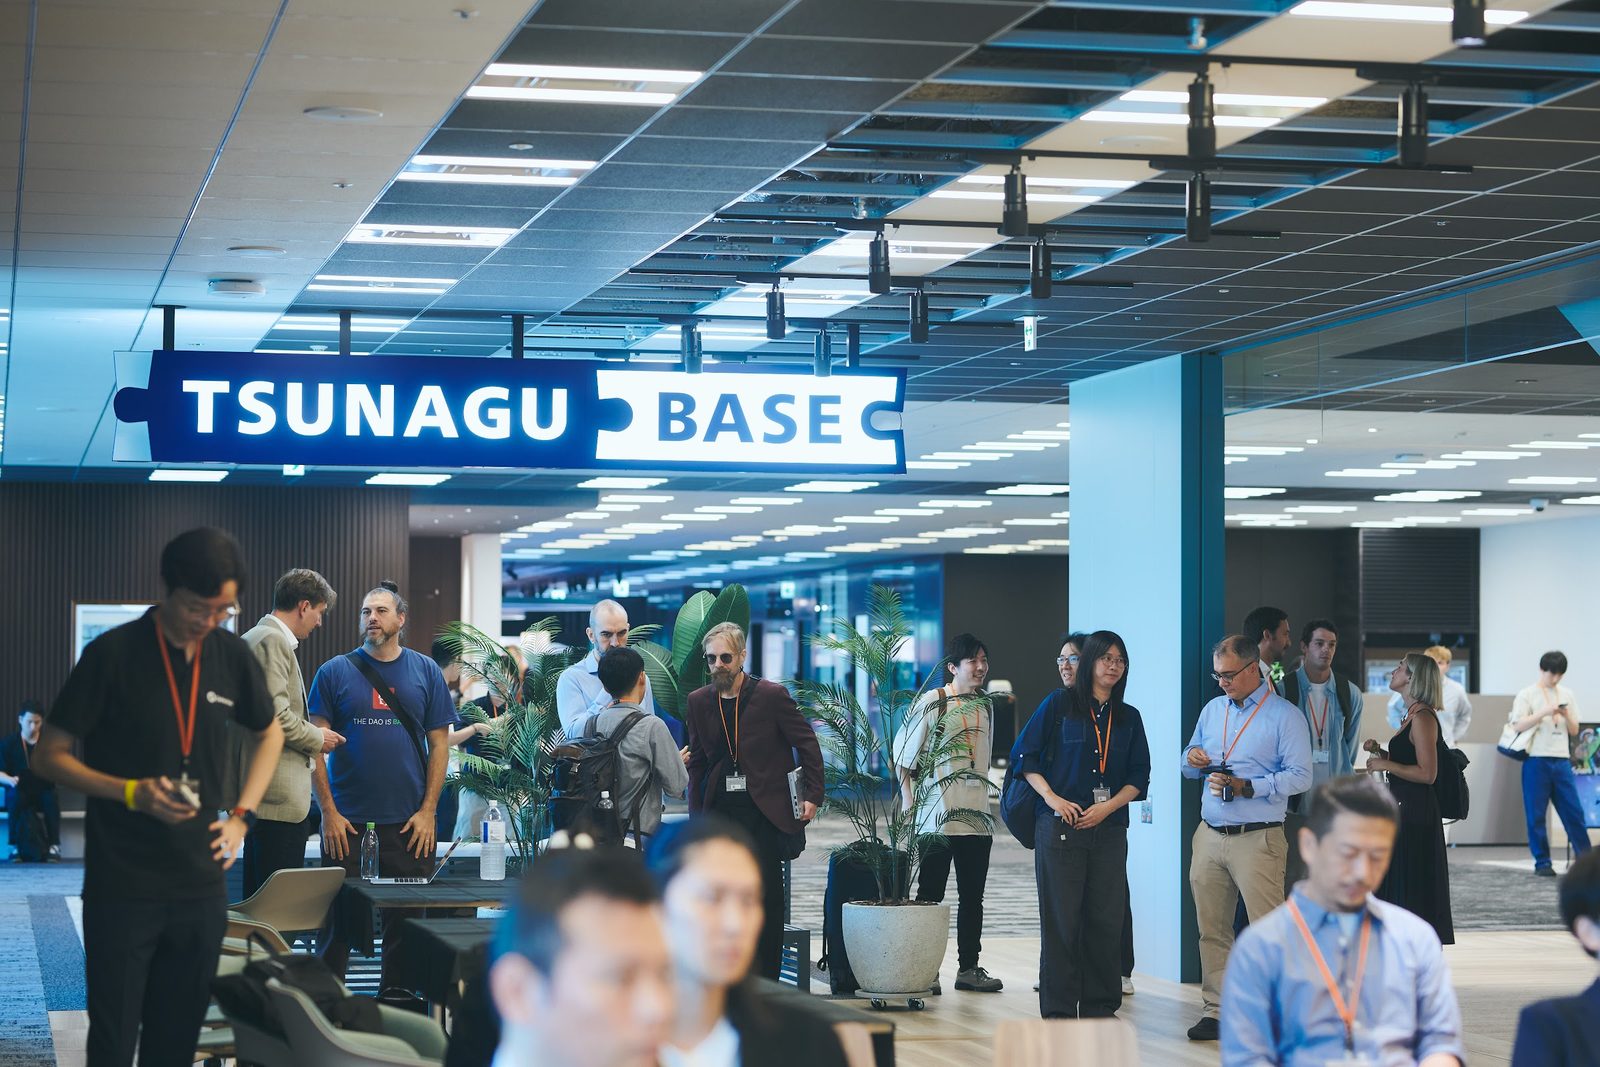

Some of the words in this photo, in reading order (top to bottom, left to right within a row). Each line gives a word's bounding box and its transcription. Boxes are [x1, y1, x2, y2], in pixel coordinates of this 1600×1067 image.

[182, 379, 569, 441] TSUNAGU
[657, 391, 842, 444] BASE
[353, 717, 367, 725] THE
[368, 718, 384, 726] DAO
[385, 718, 392, 726] IS
